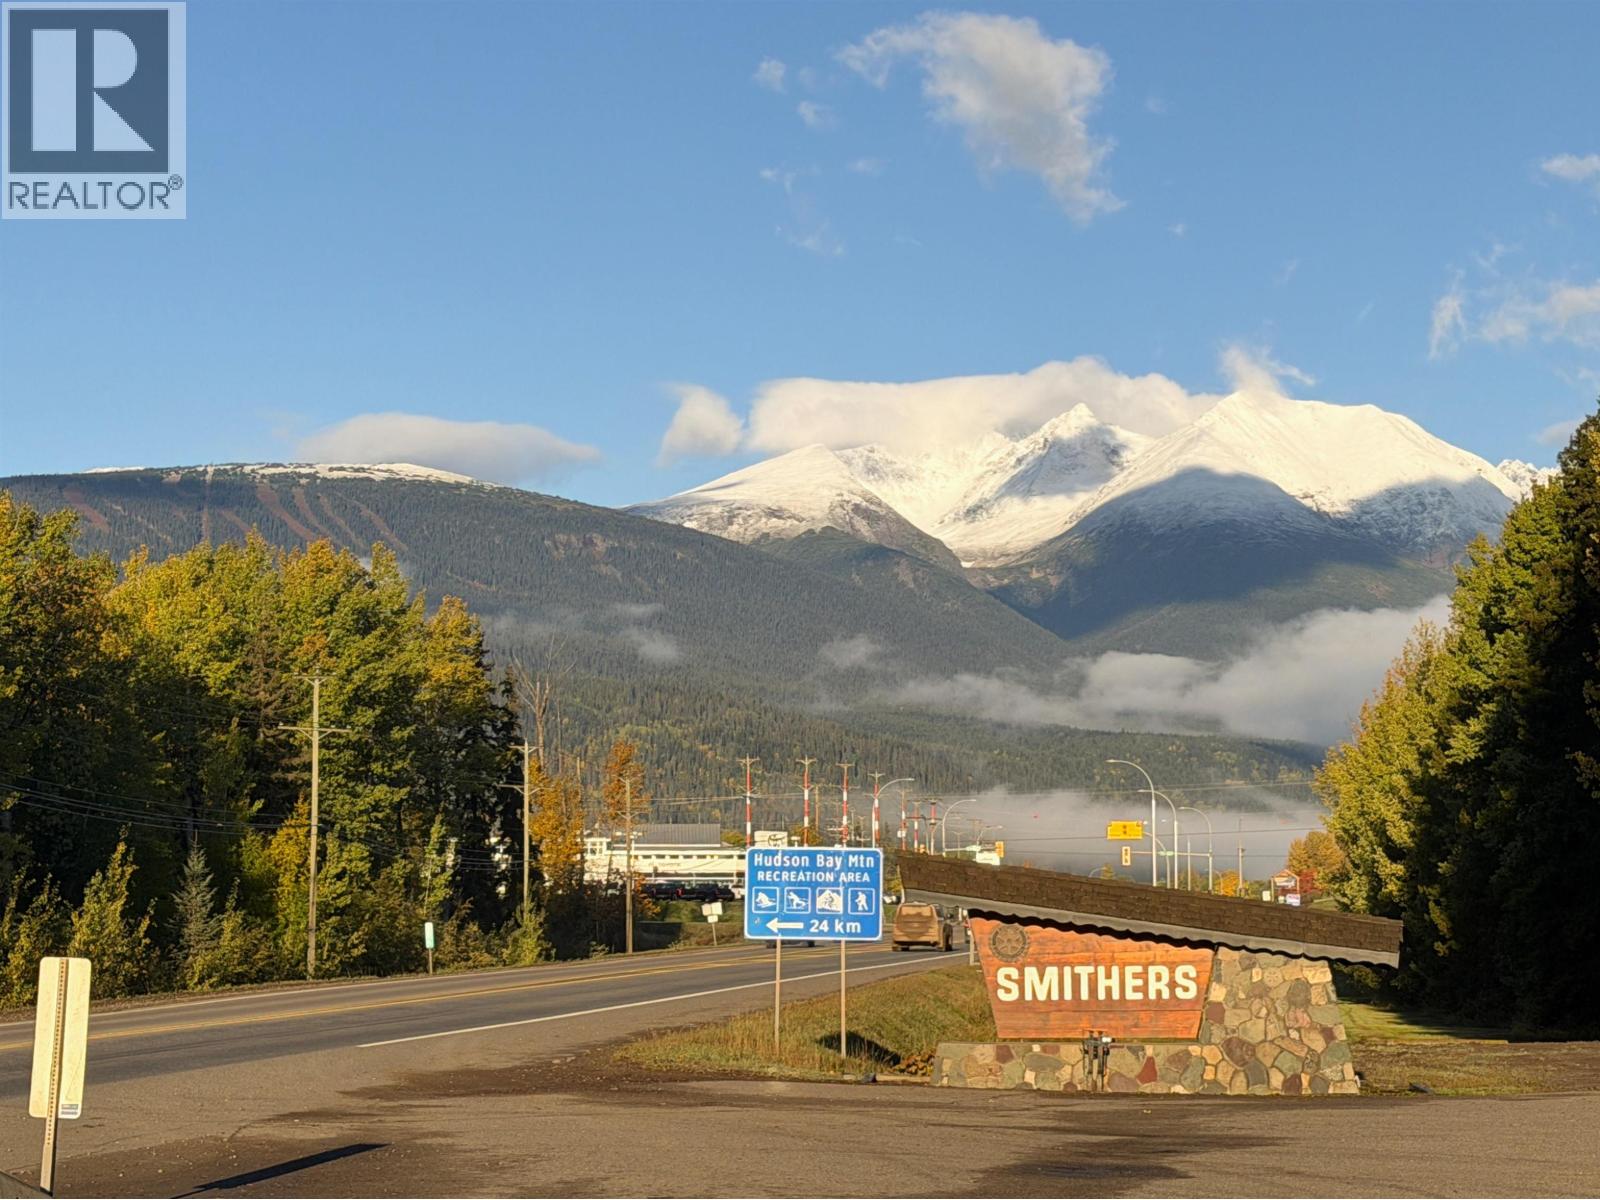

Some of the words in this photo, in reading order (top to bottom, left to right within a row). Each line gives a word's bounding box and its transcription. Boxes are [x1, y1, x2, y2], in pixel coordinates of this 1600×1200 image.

[754, 853, 809, 867] Hudson
[816, 854, 842, 870] Bay
[848, 854, 875, 868] Mtn
[757, 871, 834, 882] RECREATION
[838, 872, 870, 882] AREA
[809, 919, 829, 933] 24
[834, 919, 861, 934] km
[996, 964, 1198, 1001] SMITHERS
